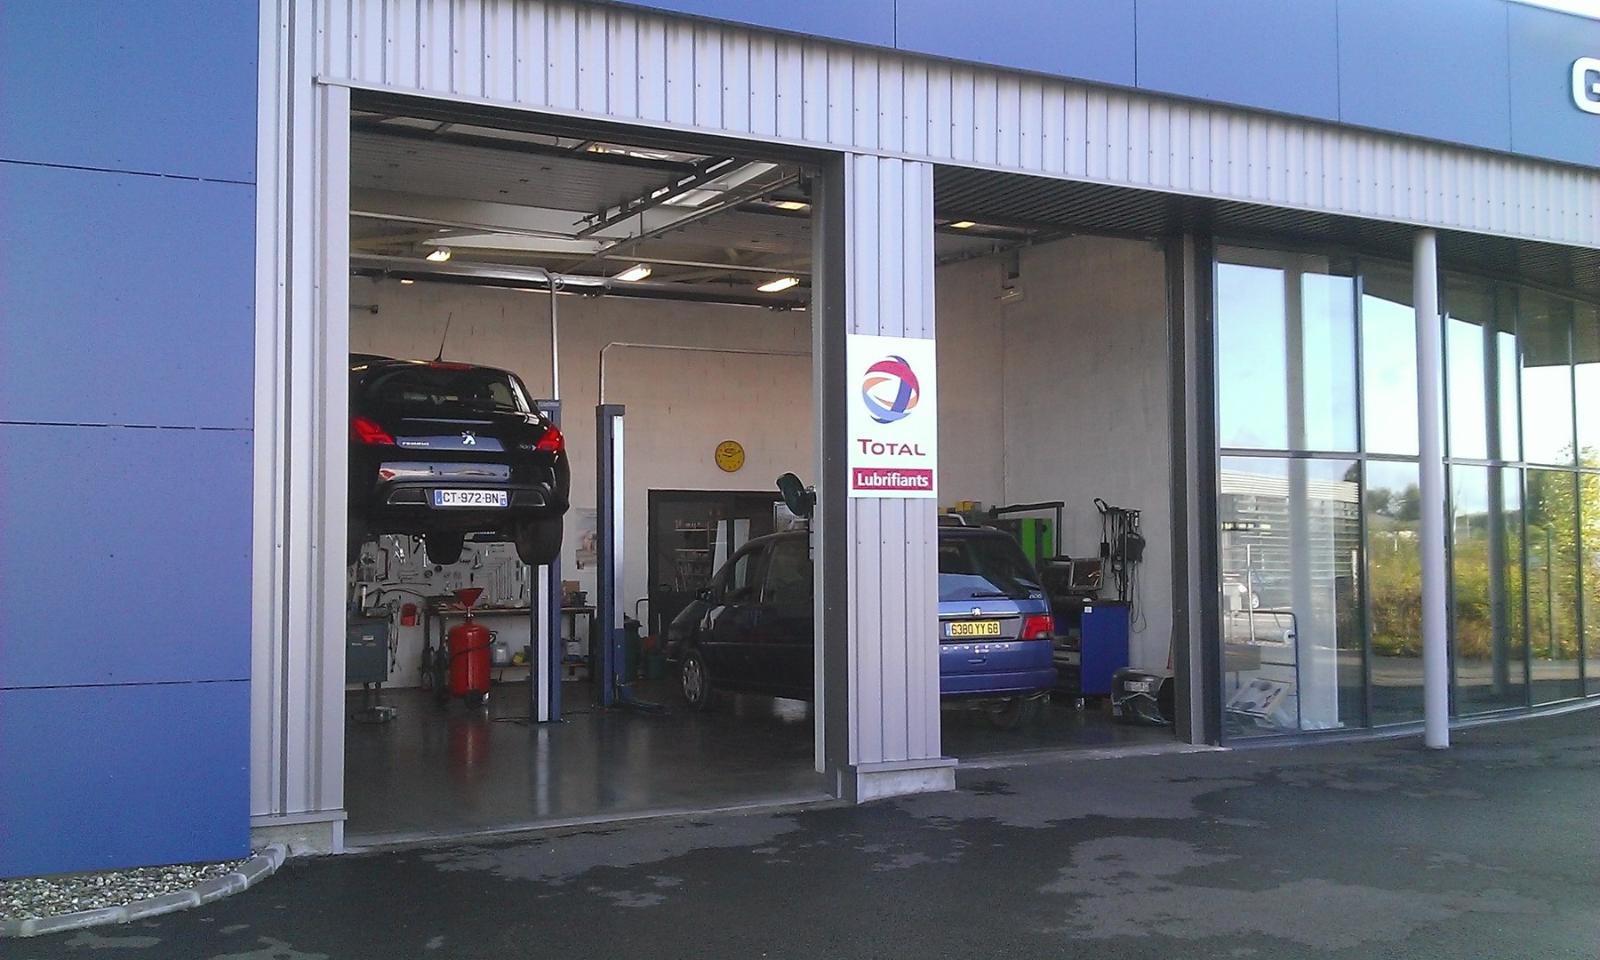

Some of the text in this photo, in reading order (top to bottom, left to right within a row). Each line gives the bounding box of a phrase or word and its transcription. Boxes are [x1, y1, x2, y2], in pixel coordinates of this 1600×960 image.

[857, 471, 929, 487] Lubrifiants
[951, 622, 999, 635] 6380 YY 68
